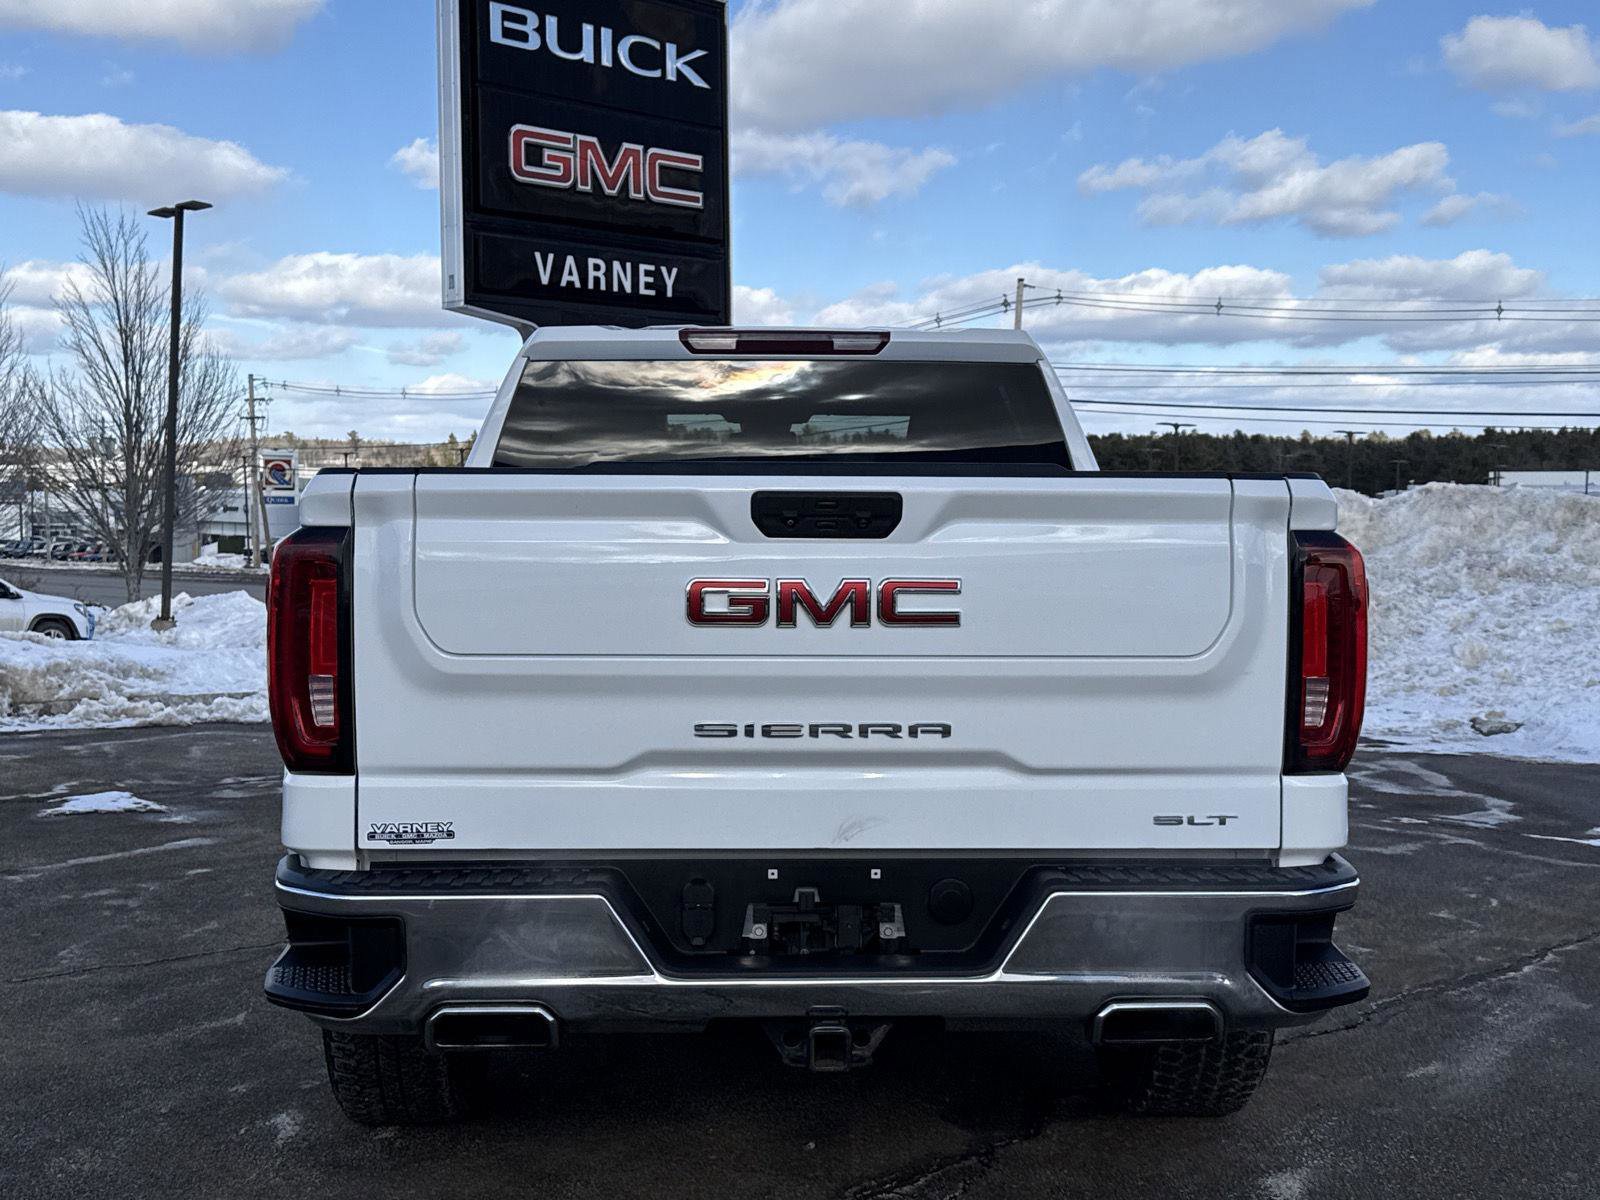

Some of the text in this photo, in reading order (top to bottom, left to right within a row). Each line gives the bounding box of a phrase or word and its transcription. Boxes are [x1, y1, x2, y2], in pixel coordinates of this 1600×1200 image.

[509, 123, 704, 209] GMC
[534, 251, 679, 298] VARNEY
[686, 577, 962, 628] GMC
[694, 722, 952, 739] SIERRA
[370, 822, 453, 833] VARNEY
[1153, 815, 1239, 826] SLT
